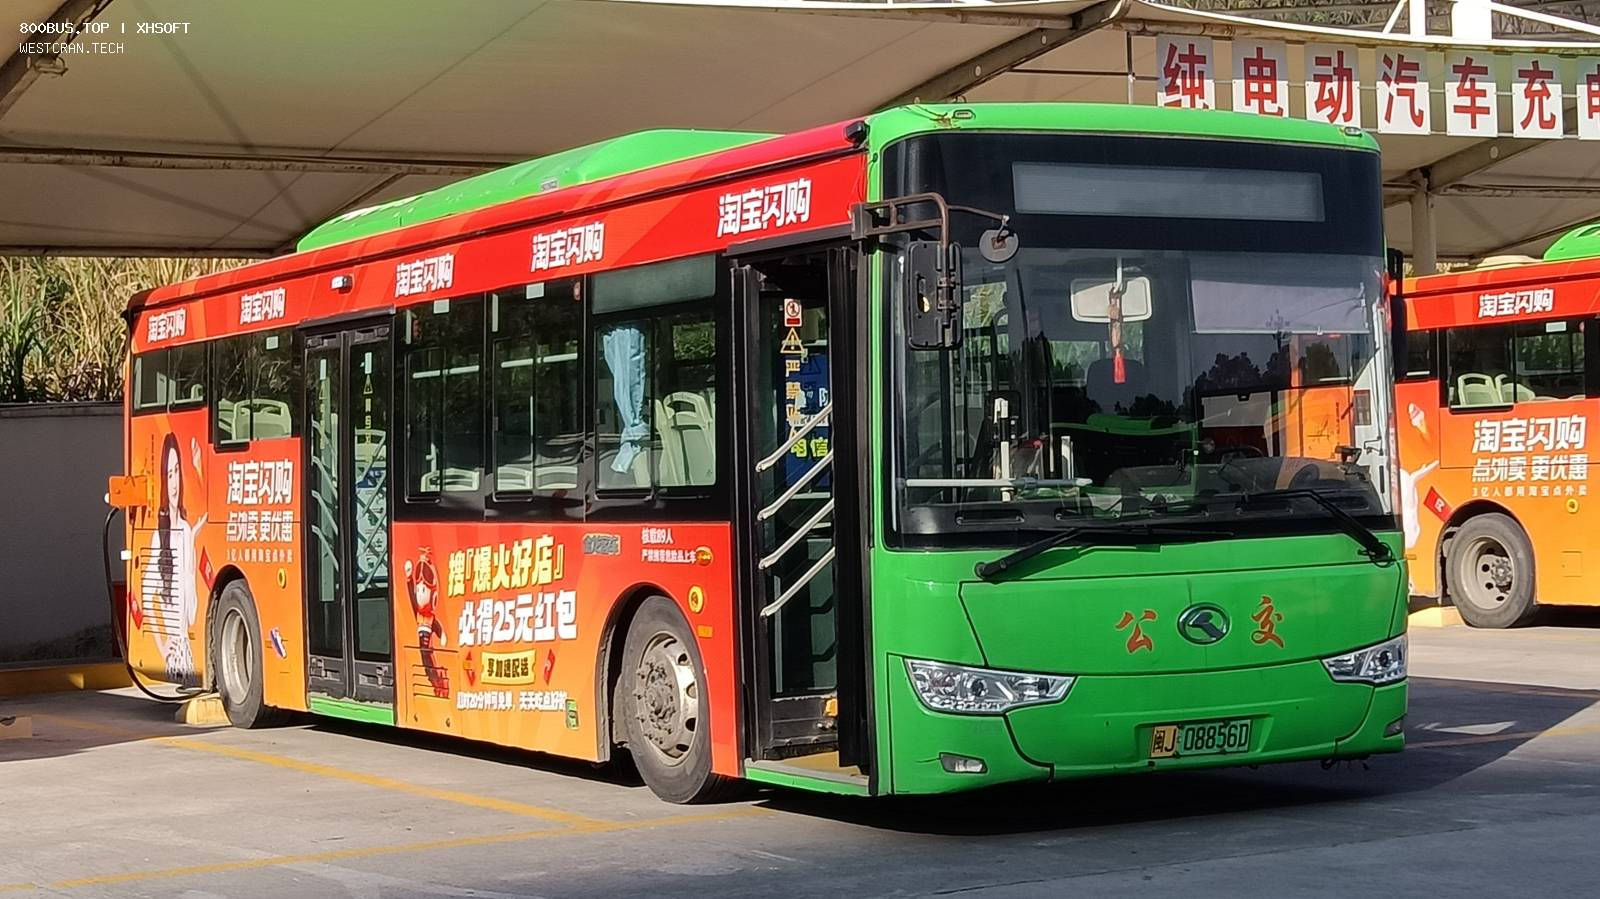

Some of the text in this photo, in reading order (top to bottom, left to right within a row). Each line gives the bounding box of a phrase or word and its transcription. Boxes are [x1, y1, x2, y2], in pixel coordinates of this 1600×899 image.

[717, 178, 812, 238] 淘宝闪购
[530, 221, 605, 273] 淘宝闪购
[395, 252, 455, 299] 淘宝闪购
[239, 286, 286, 326] 淘宝闪购
[1477, 287, 1554, 319] 淘宝闪购
[147, 307, 186, 343] 淘宝闪购
[1471, 413, 1587, 454] 淘宝闪购
[226, 458, 294, 505] 淘宝闪购
[1471, 454, 1588, 483] 点外卖 更优惠
[226, 510, 293, 542] 点外卖 更优惠
[458, 590, 578, 647] 必得25元红包
